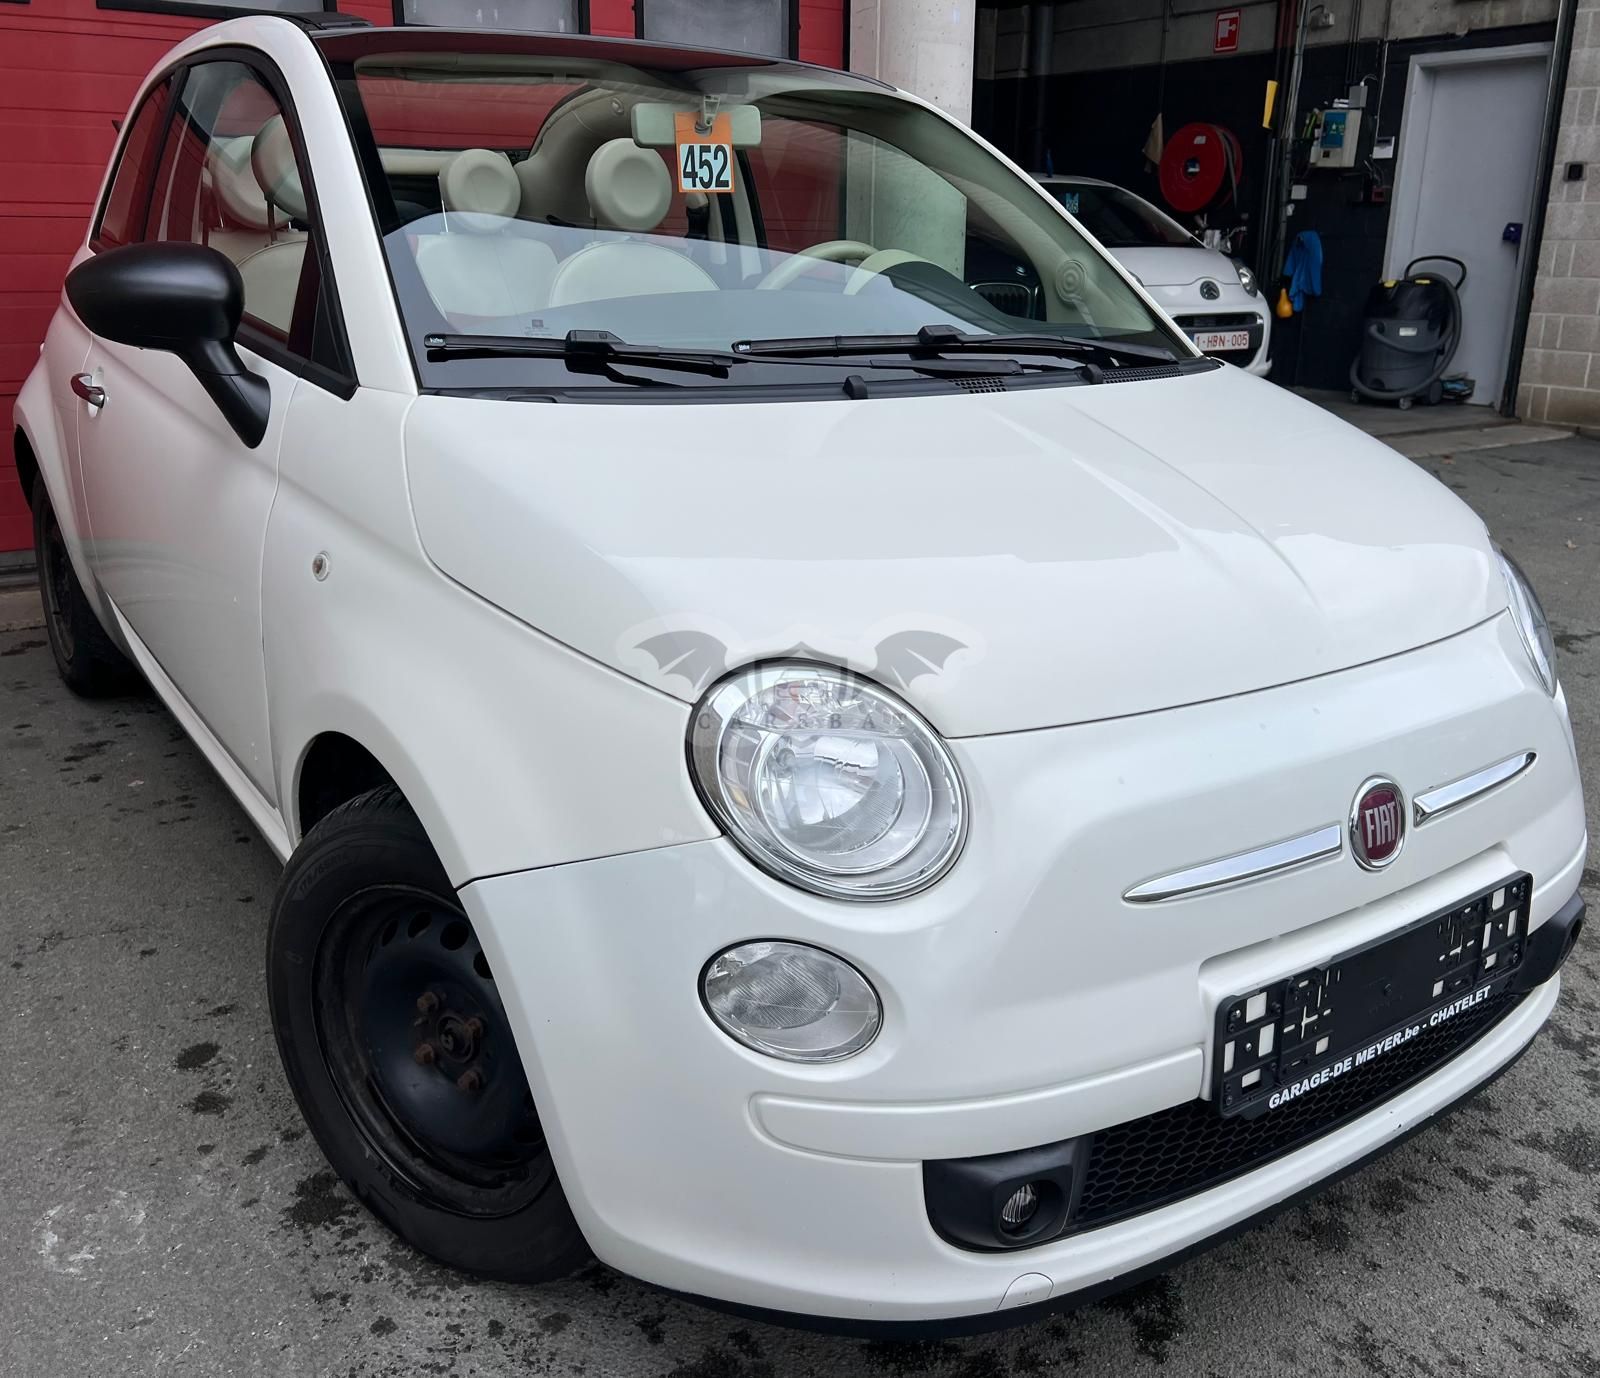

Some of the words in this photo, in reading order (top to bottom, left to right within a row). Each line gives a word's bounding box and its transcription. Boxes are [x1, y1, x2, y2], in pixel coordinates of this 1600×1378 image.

[683, 145, 730, 189] 452
[1364, 801, 1396, 849] FIAT
[1268, 1056, 1353, 1109] GARAGE-DE
[1355, 1023, 1420, 1066] MEYER.be
[1429, 985, 1492, 1026] CHATELET
